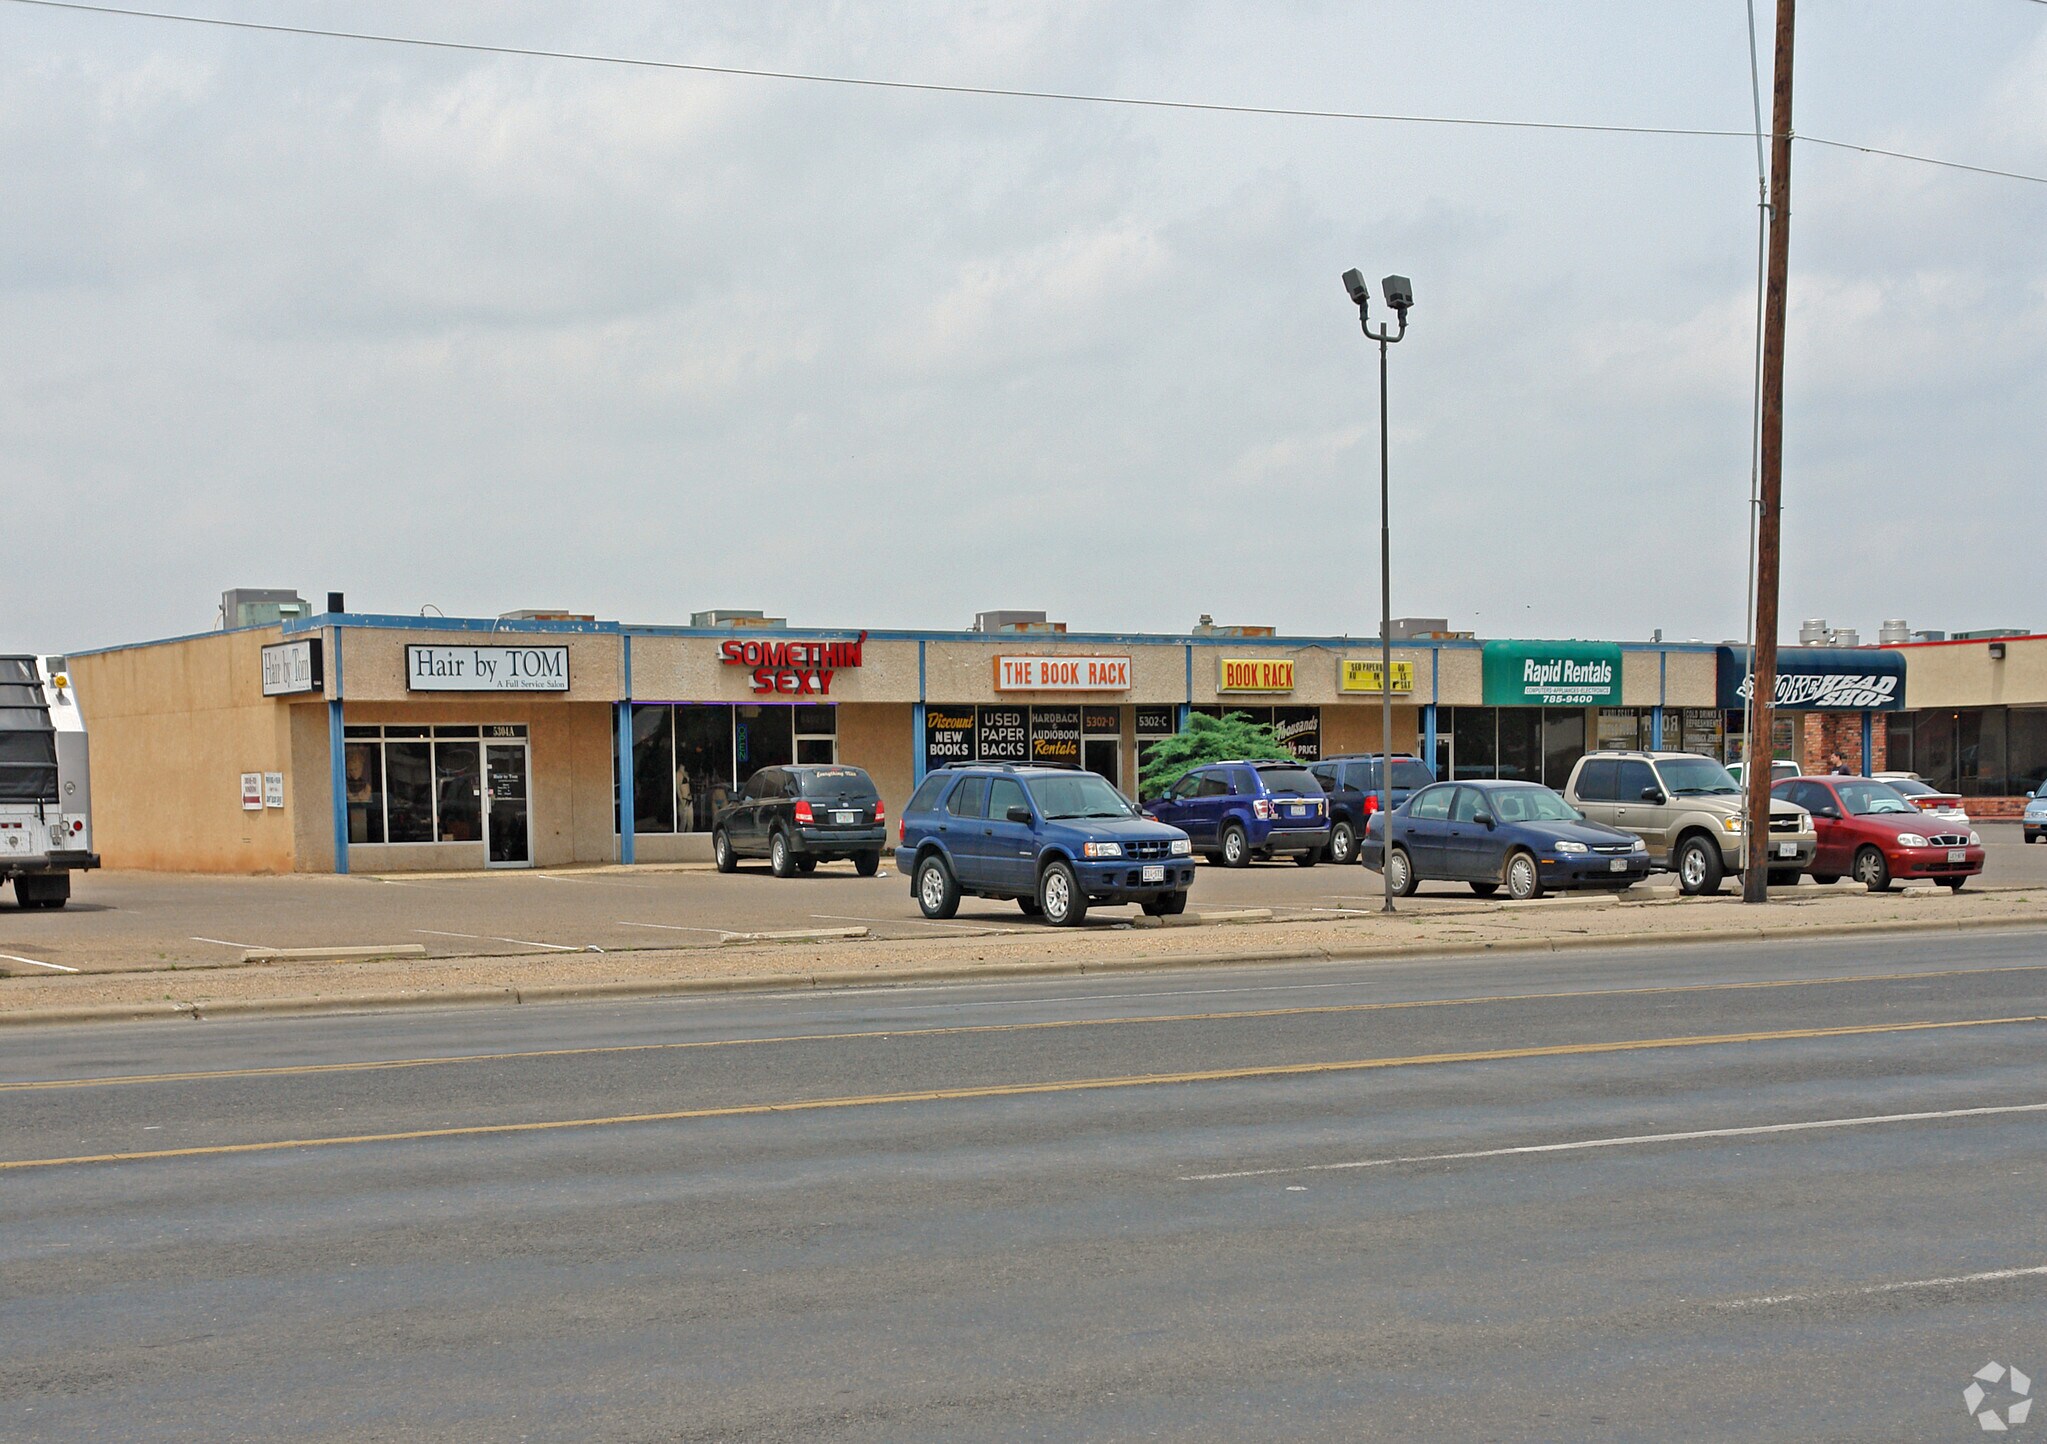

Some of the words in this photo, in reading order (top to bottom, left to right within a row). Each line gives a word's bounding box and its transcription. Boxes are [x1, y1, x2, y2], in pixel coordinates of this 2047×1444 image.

[264, 652, 281, 685] Hair
[282, 650, 291, 688] by
[292, 648, 310, 682] Tom
[415, 650, 464, 677] Hair
[474, 650, 497, 682] by
[506, 650, 563, 677] TOM
[1523, 659, 1562, 686] Rapid
[1563, 660, 1612, 683] Rentals
[1004, 662, 1032, 684] THE
[1041, 662, 1079, 684] BOOK
[1088, 663, 1127, 685] RACK
[1227, 663, 1258, 687] BOOK
[1264, 664, 1293, 688] RACK
[753, 668, 835, 695] SEXY
[1543, 695, 1593, 703] 785-9400
[927, 712, 973, 728] Discount
[984, 713, 1020, 726] USED
[1032, 713, 1078, 723] HARDBACK
[1086, 716, 1114, 727] 5302-D
[1139, 716, 1167, 727] 5302-C
[1275, 715, 1318, 740] Thousands
[935, 731, 963, 742] NEW
[981, 728, 1024, 741] PAPER
[1032, 730, 1079, 740] AUDIOBOOK
[930, 744, 968, 755] BOOKS
[981, 743, 1024, 755] BACKS
[1034, 740, 1076, 755] Rentals
[1298, 745, 1317, 754] PRICE
